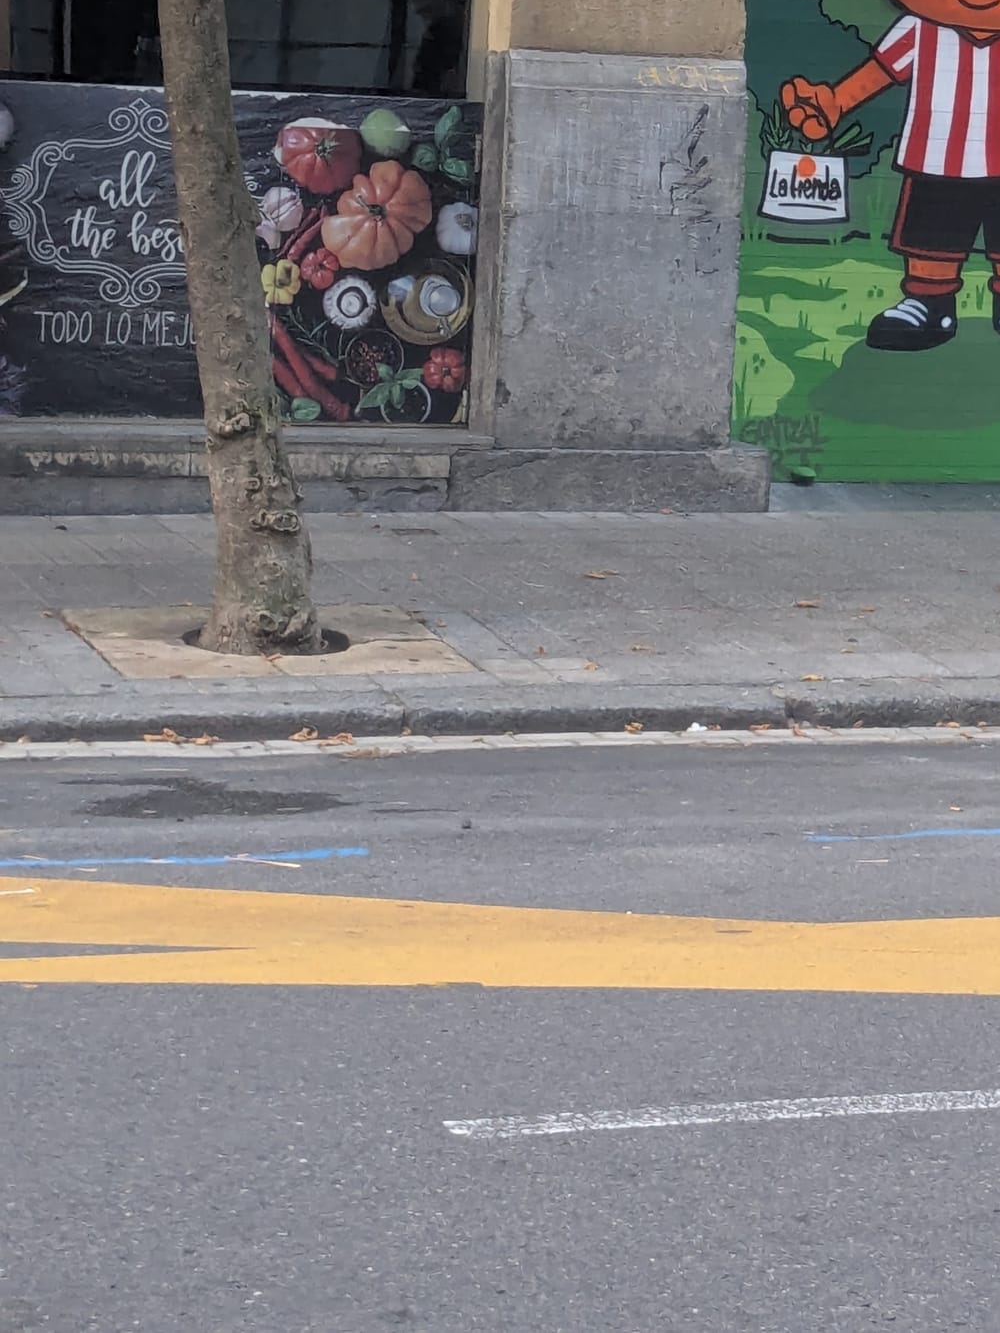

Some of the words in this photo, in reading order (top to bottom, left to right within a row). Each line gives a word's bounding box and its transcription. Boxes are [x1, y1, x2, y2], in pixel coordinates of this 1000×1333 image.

[99, 151, 157, 209] all
[64, 206, 116, 258] the
[33, 311, 93, 343] TODO
[105, 312, 131, 345] LO
[142, 311, 198, 347] MEJ
